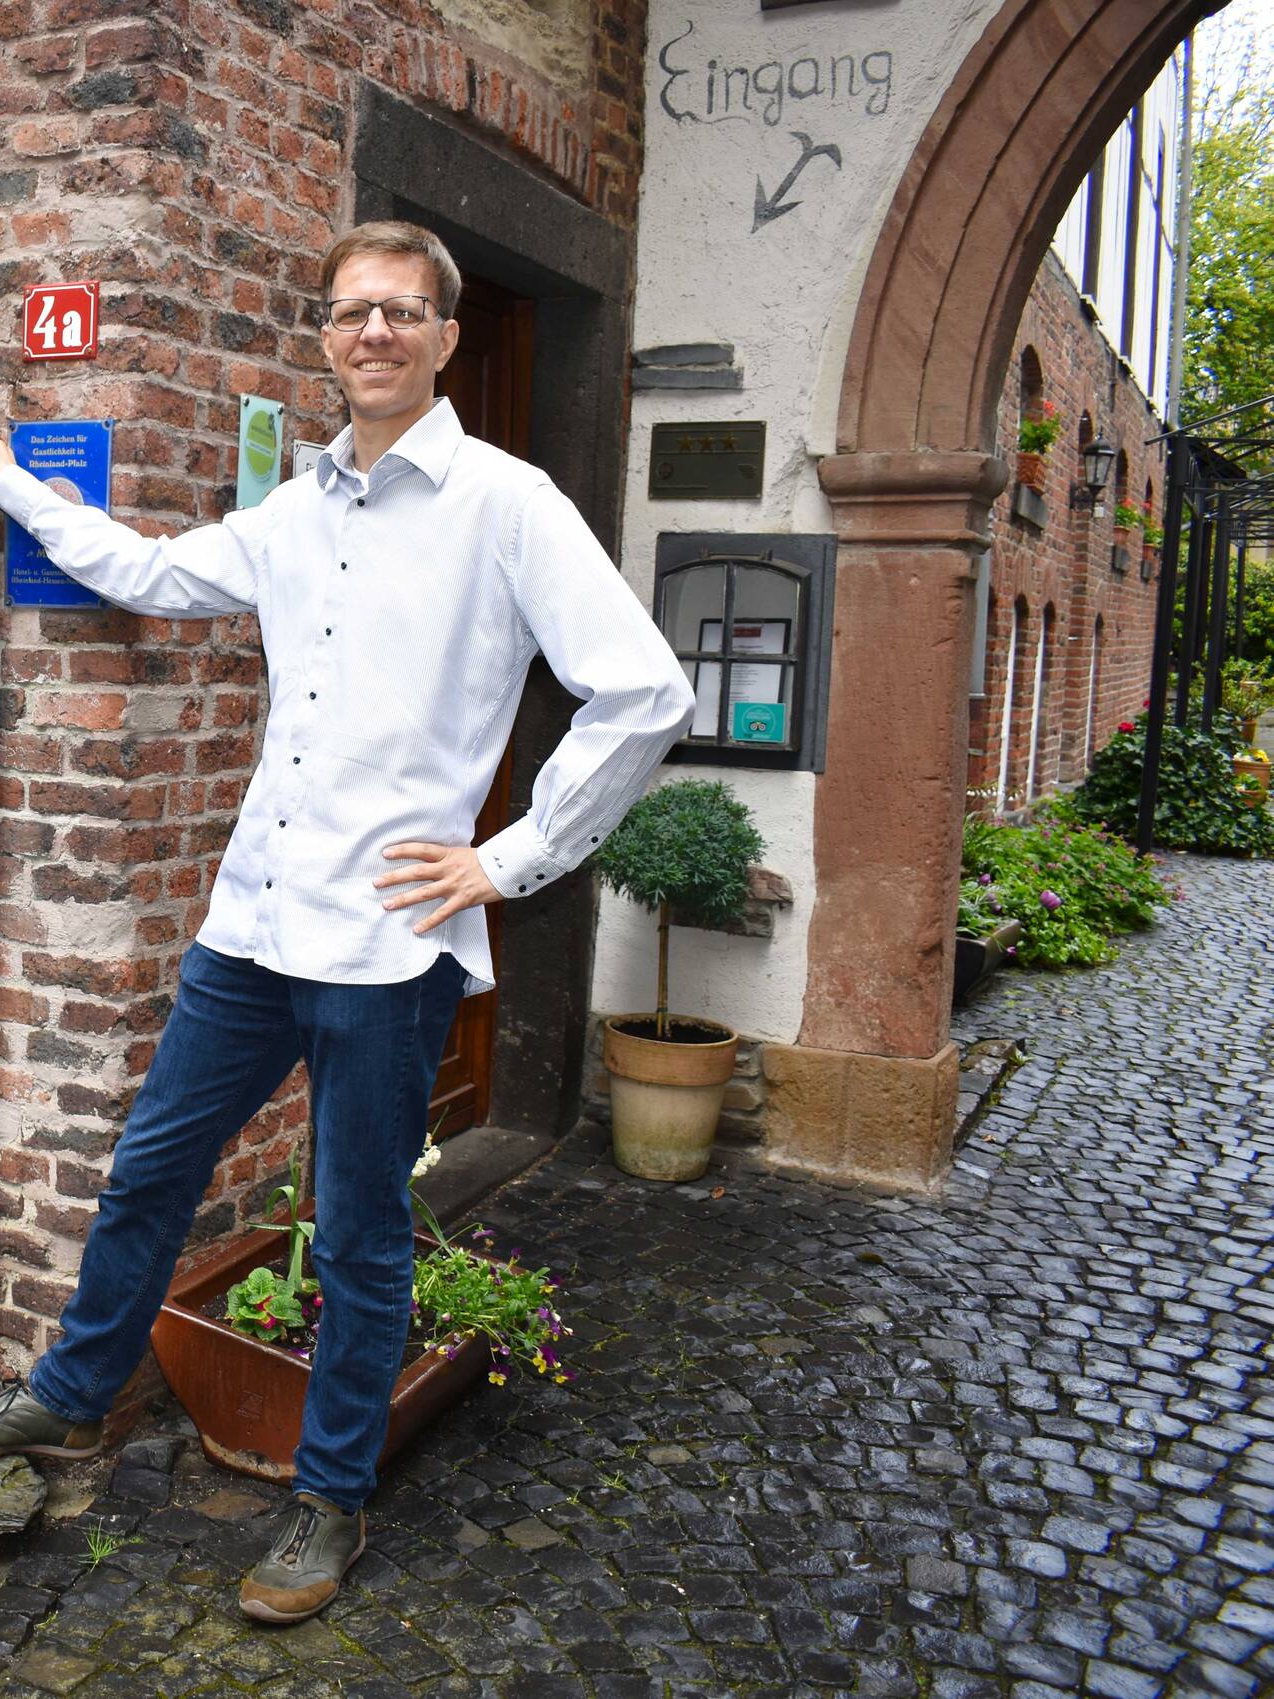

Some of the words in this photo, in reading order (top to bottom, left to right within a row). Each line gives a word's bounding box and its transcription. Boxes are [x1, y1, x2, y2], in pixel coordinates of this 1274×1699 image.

[659, 20, 892, 126] Eingang
[32, 295, 83, 349] 4a
[30, 435, 45, 444] Das
[46, 434, 75, 443] Zeichen
[77, 434, 88, 443] für
[32, 447, 76, 456] Gastlichkeit
[77, 447, 85, 455] in
[29, 459, 87, 468] Rheinland-Pfalz
